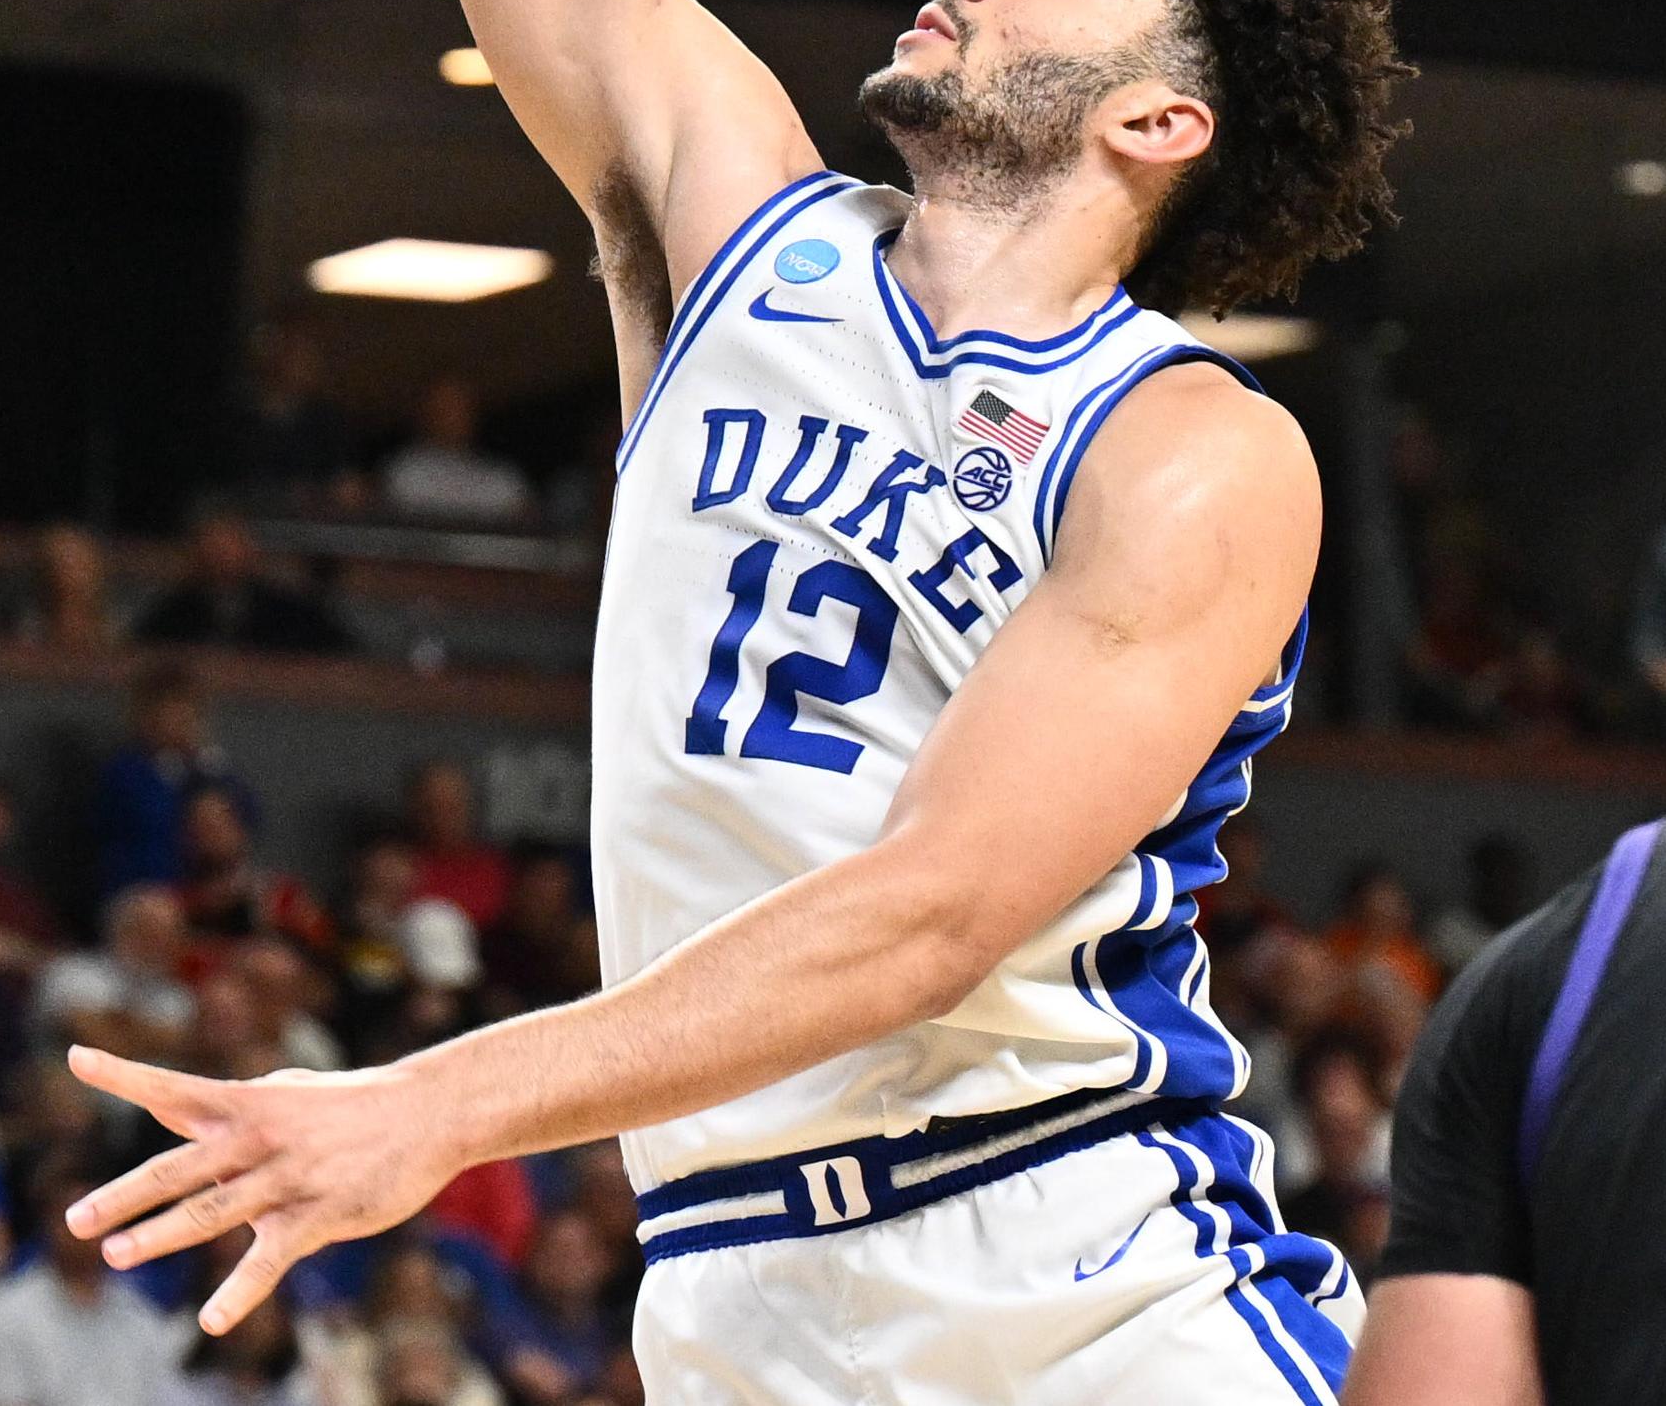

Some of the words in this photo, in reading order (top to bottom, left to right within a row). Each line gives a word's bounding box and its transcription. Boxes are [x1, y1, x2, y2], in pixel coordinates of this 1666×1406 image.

[691, 407, 1023, 634] DUKE
[962, 466, 1011, 490] ACC
[684, 539, 903, 775] 12
[798, 1155, 872, 1227] D
